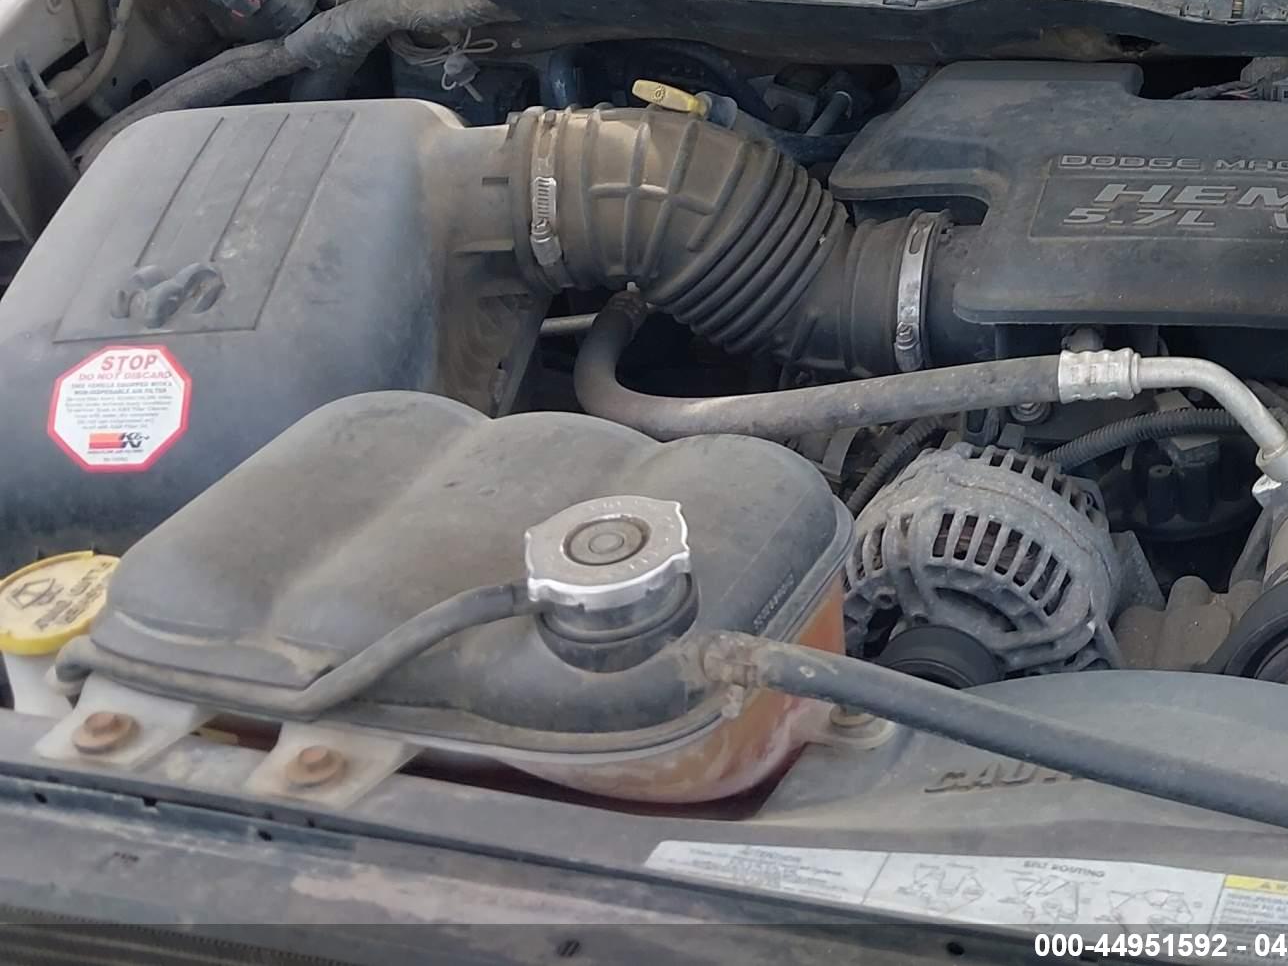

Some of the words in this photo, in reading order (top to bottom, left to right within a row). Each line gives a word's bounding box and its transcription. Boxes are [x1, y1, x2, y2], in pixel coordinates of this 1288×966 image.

[1060, 154, 1200, 170] DODGE
[1063, 206, 1215, 228] 5.7L
[102, 354, 157, 371] STOP
